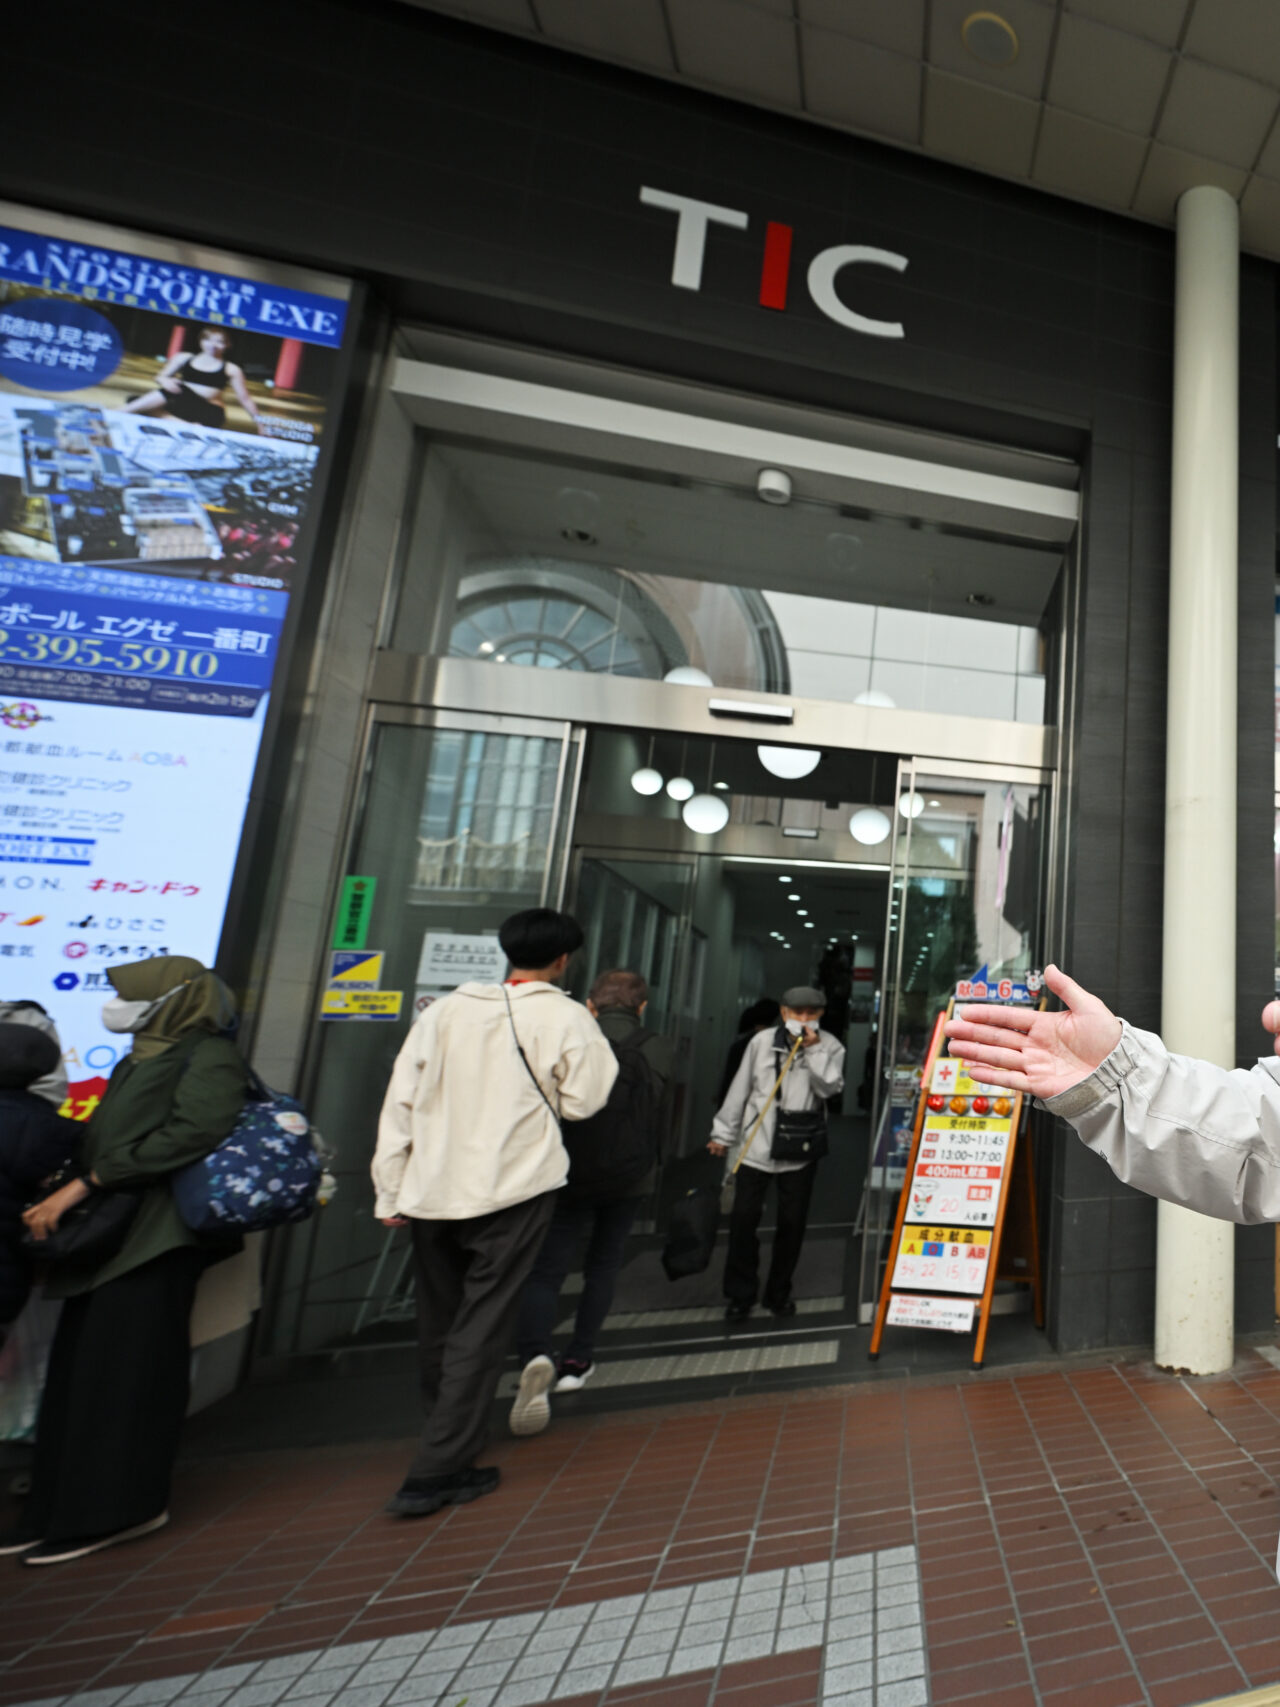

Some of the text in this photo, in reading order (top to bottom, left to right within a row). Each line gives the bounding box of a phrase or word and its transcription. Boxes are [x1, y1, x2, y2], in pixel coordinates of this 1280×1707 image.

[640, 185, 908, 338] TIC
[257, 298, 339, 337] EXE
[91, 614, 180, 643] エグゼ
[182, 625, 273, 655] 一番町
[949, 1119, 987, 1131] 受付時間
[925, 1166, 988, 1179] 400mL献血
[919, 1229, 974, 1244] 成分献血
[907, 1243, 986, 1260] A O B AB
